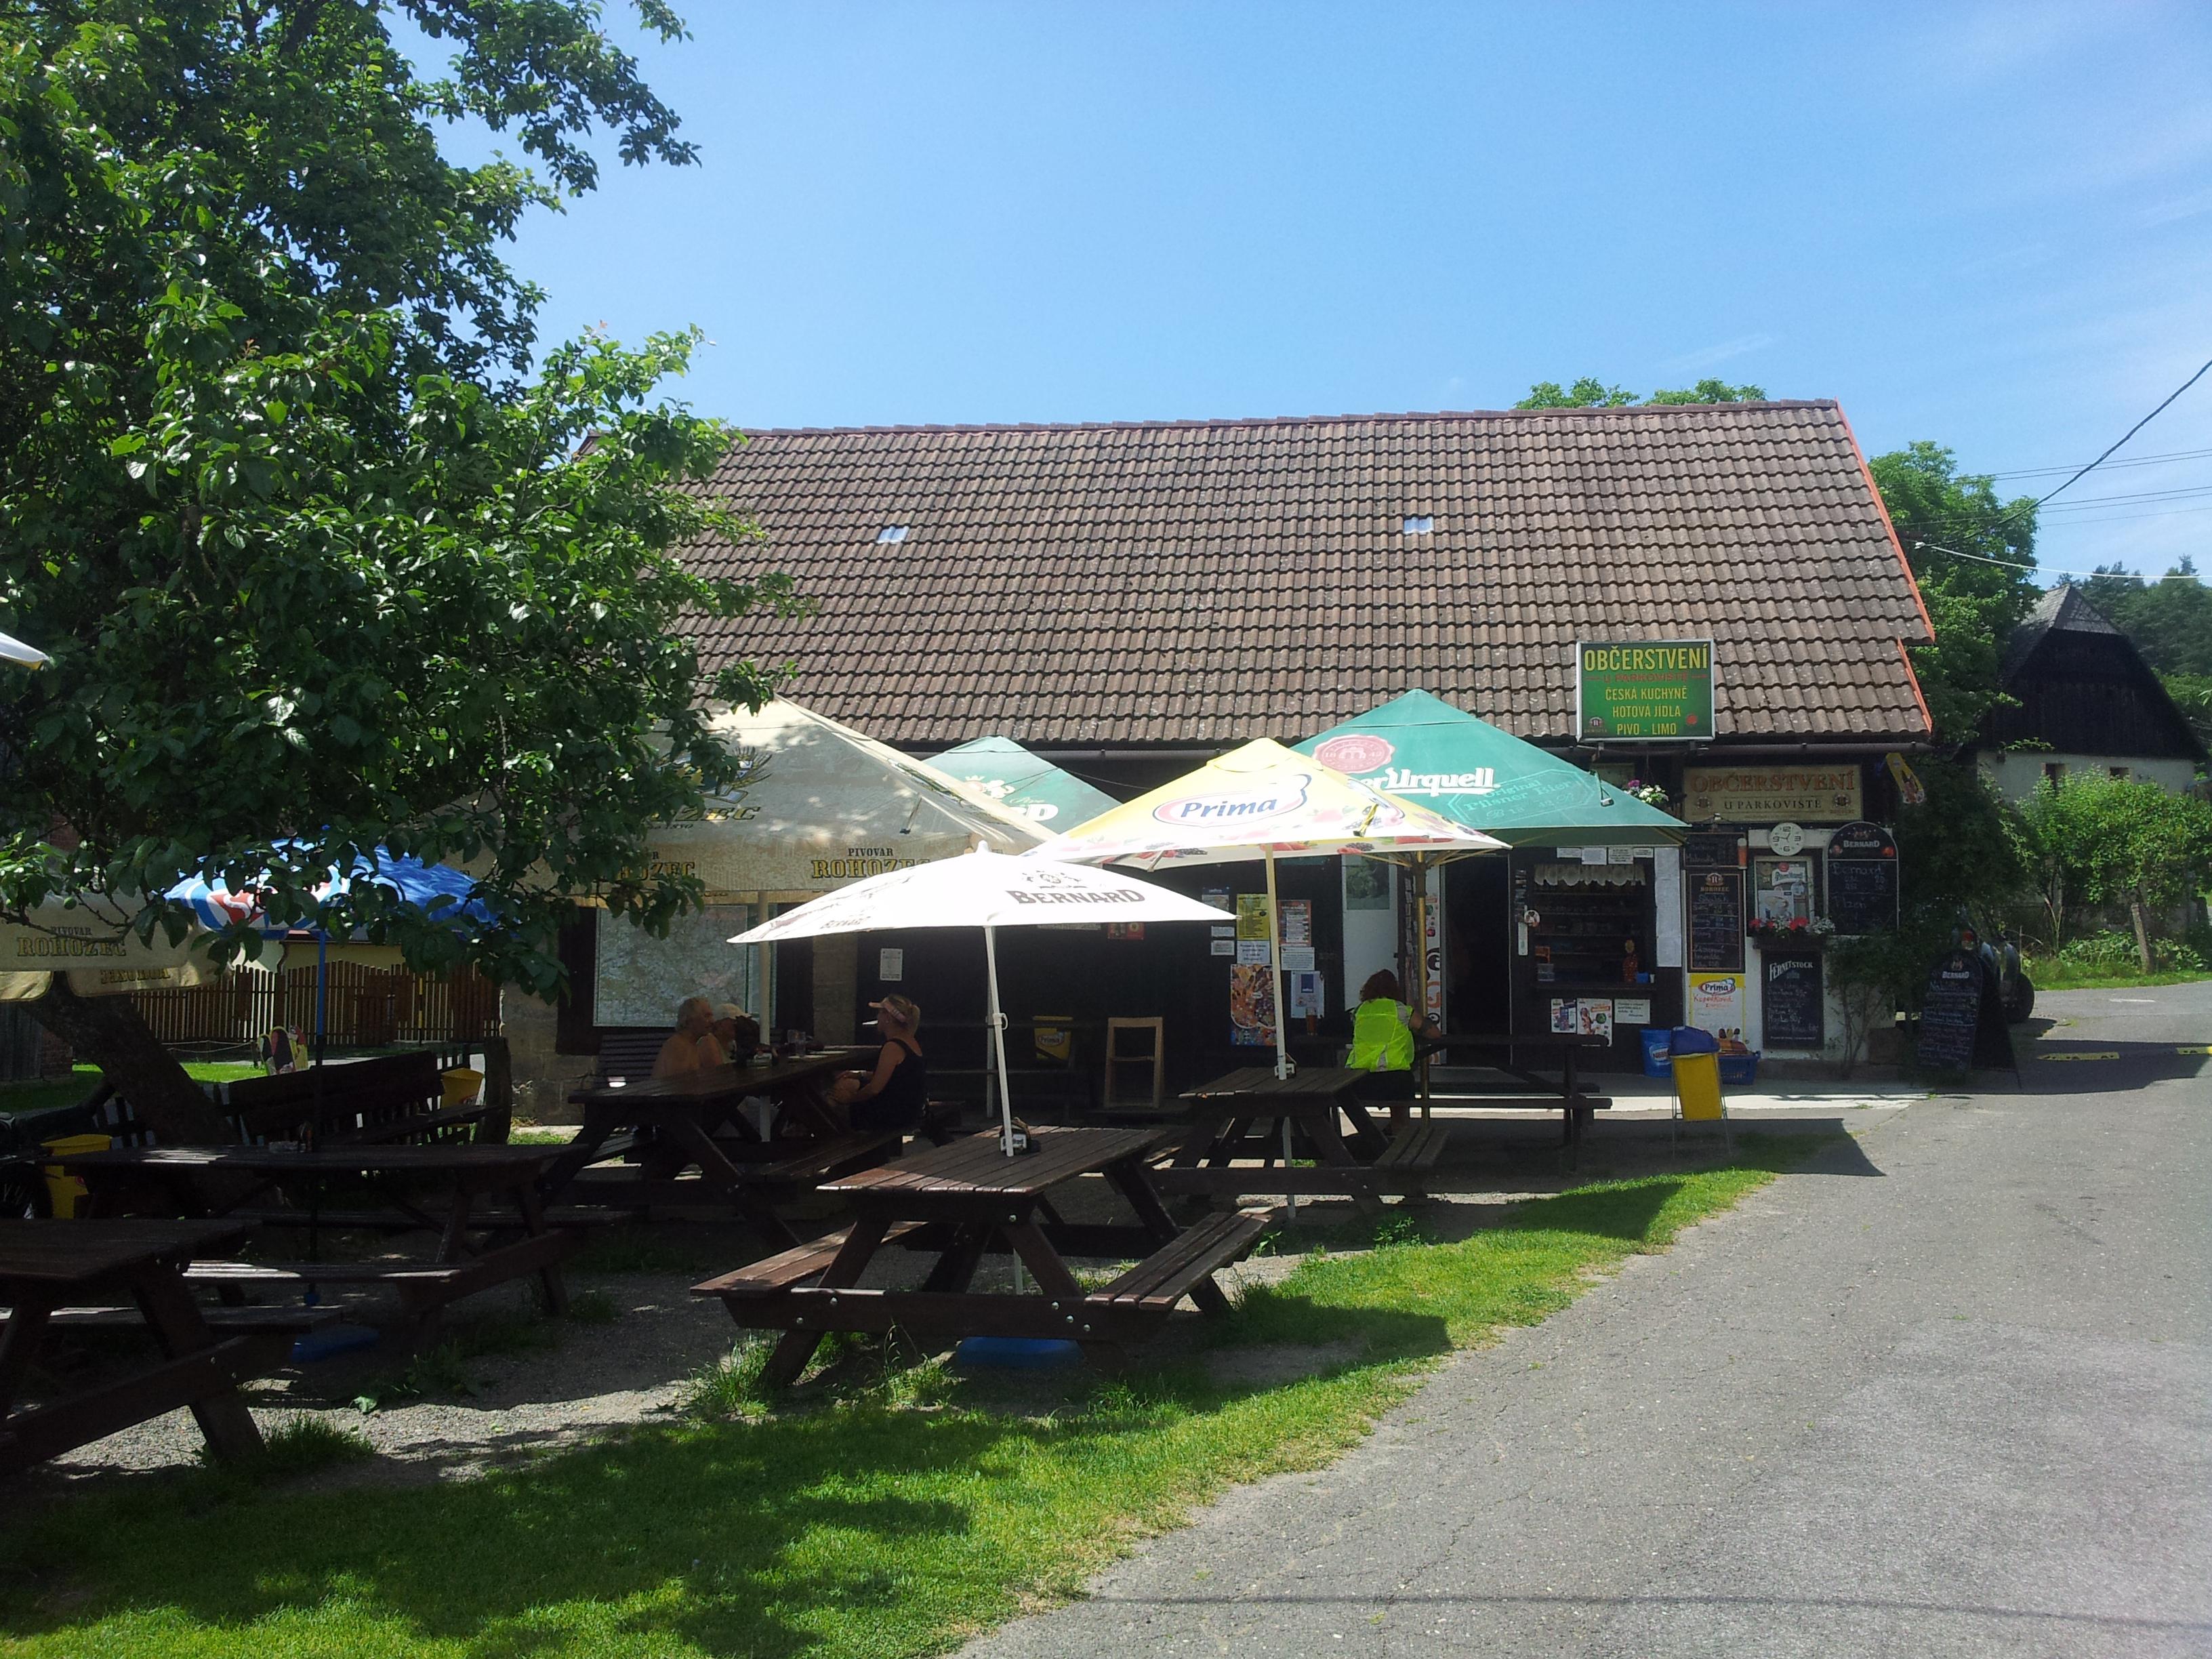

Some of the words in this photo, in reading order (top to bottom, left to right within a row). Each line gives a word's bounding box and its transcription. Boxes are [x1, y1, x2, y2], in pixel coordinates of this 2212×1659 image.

[1584, 644, 1708, 671] OBČERSTVENÍ
[1605, 687, 1637, 701] ČESKÁ
[1612, 704, 1651, 718] HOTOVÁ
[1654, 703, 1681, 718] JÍDLA
[1617, 723, 1640, 735] PIVO
[1652, 722, 1677, 735] LIMO
[1483, 780, 1542, 798] Original
[1690, 770, 1855, 793] OBČERSTVENÍ
[1181, 799, 1277, 818] Prima
[1464, 792, 1528, 811] Pilsner
[1725, 801, 1732, 809] U
[848, 848, 894, 857] PIVOVAR
[1006, 889, 1145, 904] BERNARD
[1942, 971, 1969, 979] BERNARD
[1705, 983, 1729, 992] Prima
